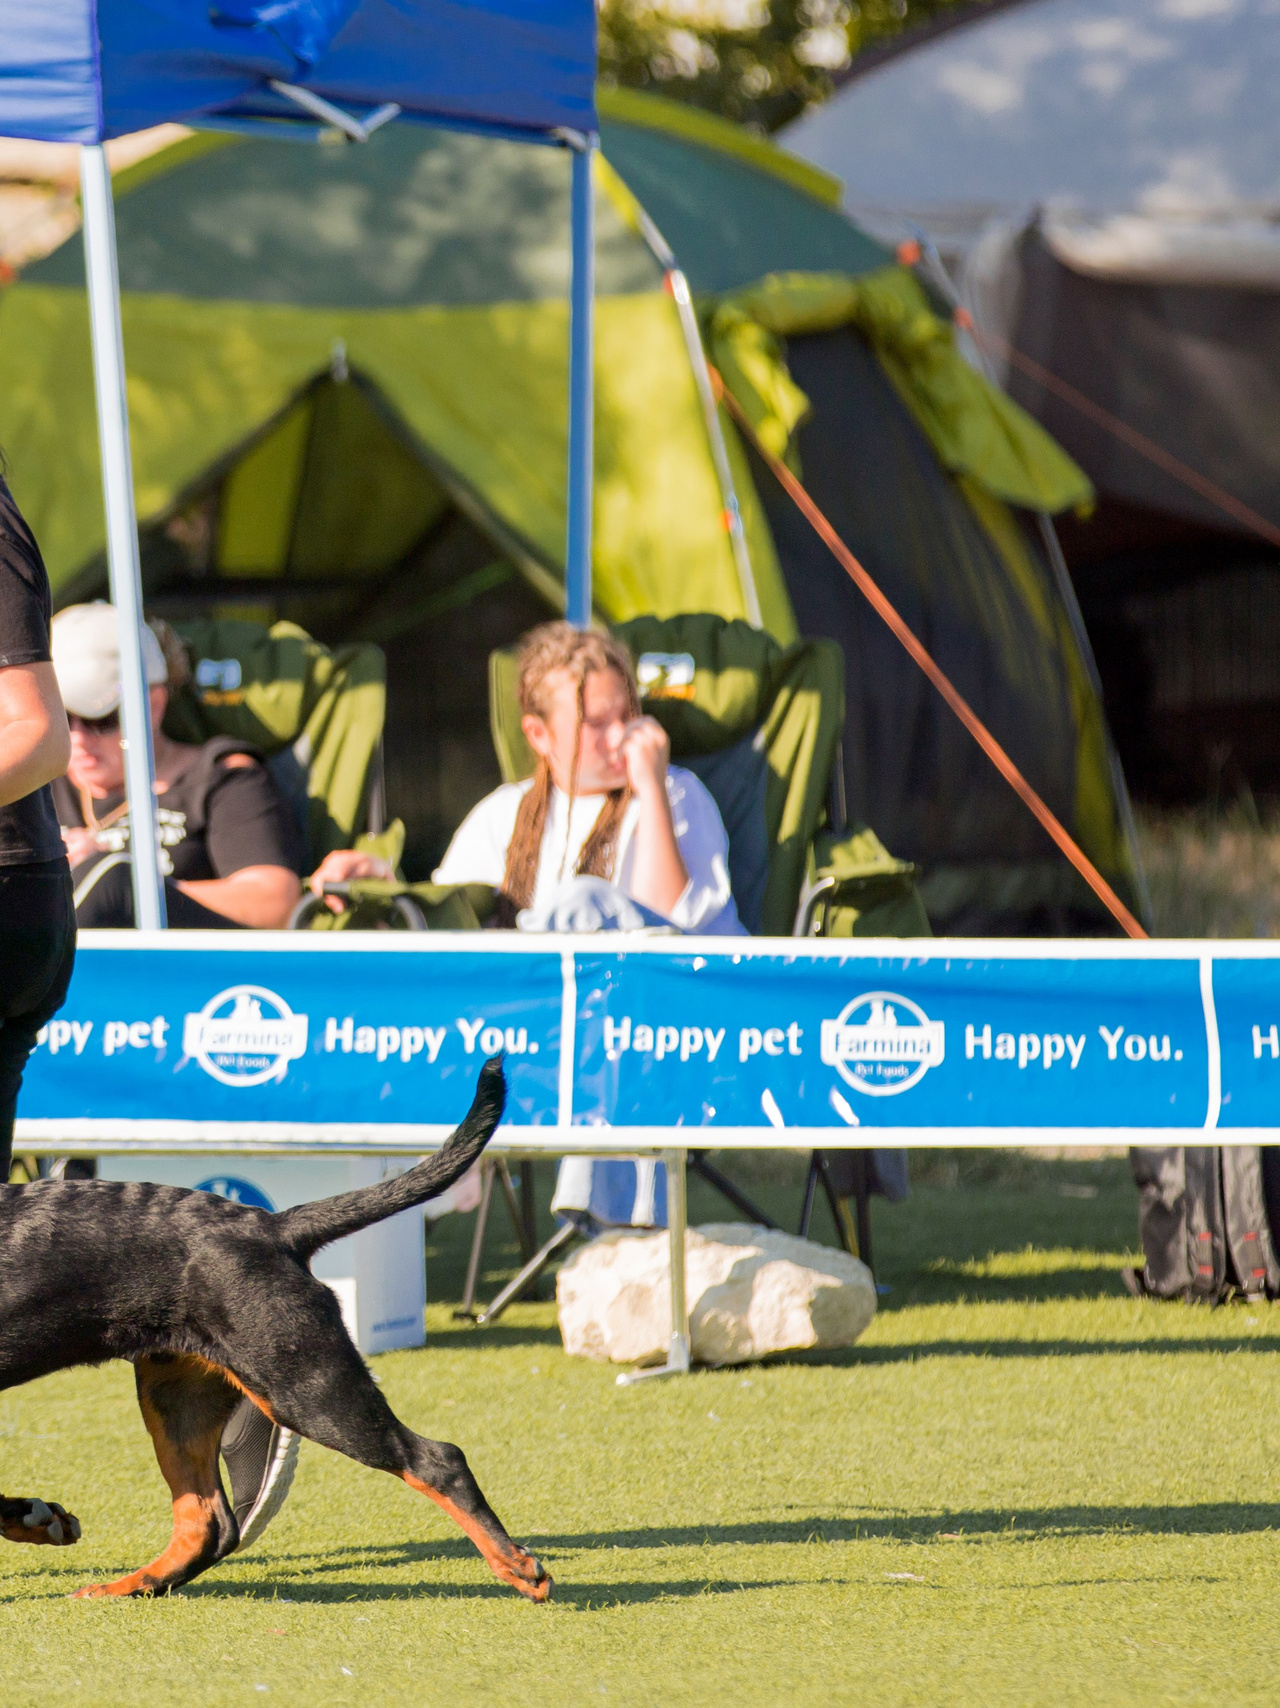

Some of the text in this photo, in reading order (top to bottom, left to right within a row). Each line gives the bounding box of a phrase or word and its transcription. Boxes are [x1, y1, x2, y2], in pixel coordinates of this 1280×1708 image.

[103, 1015, 170, 1057] pet
[324, 1017, 539, 1063] Happy You.
[603, 1015, 804, 1063] Happy pet
[835, 1031, 931, 1054] Farmina
[964, 1023, 1184, 1069] Happy You.
